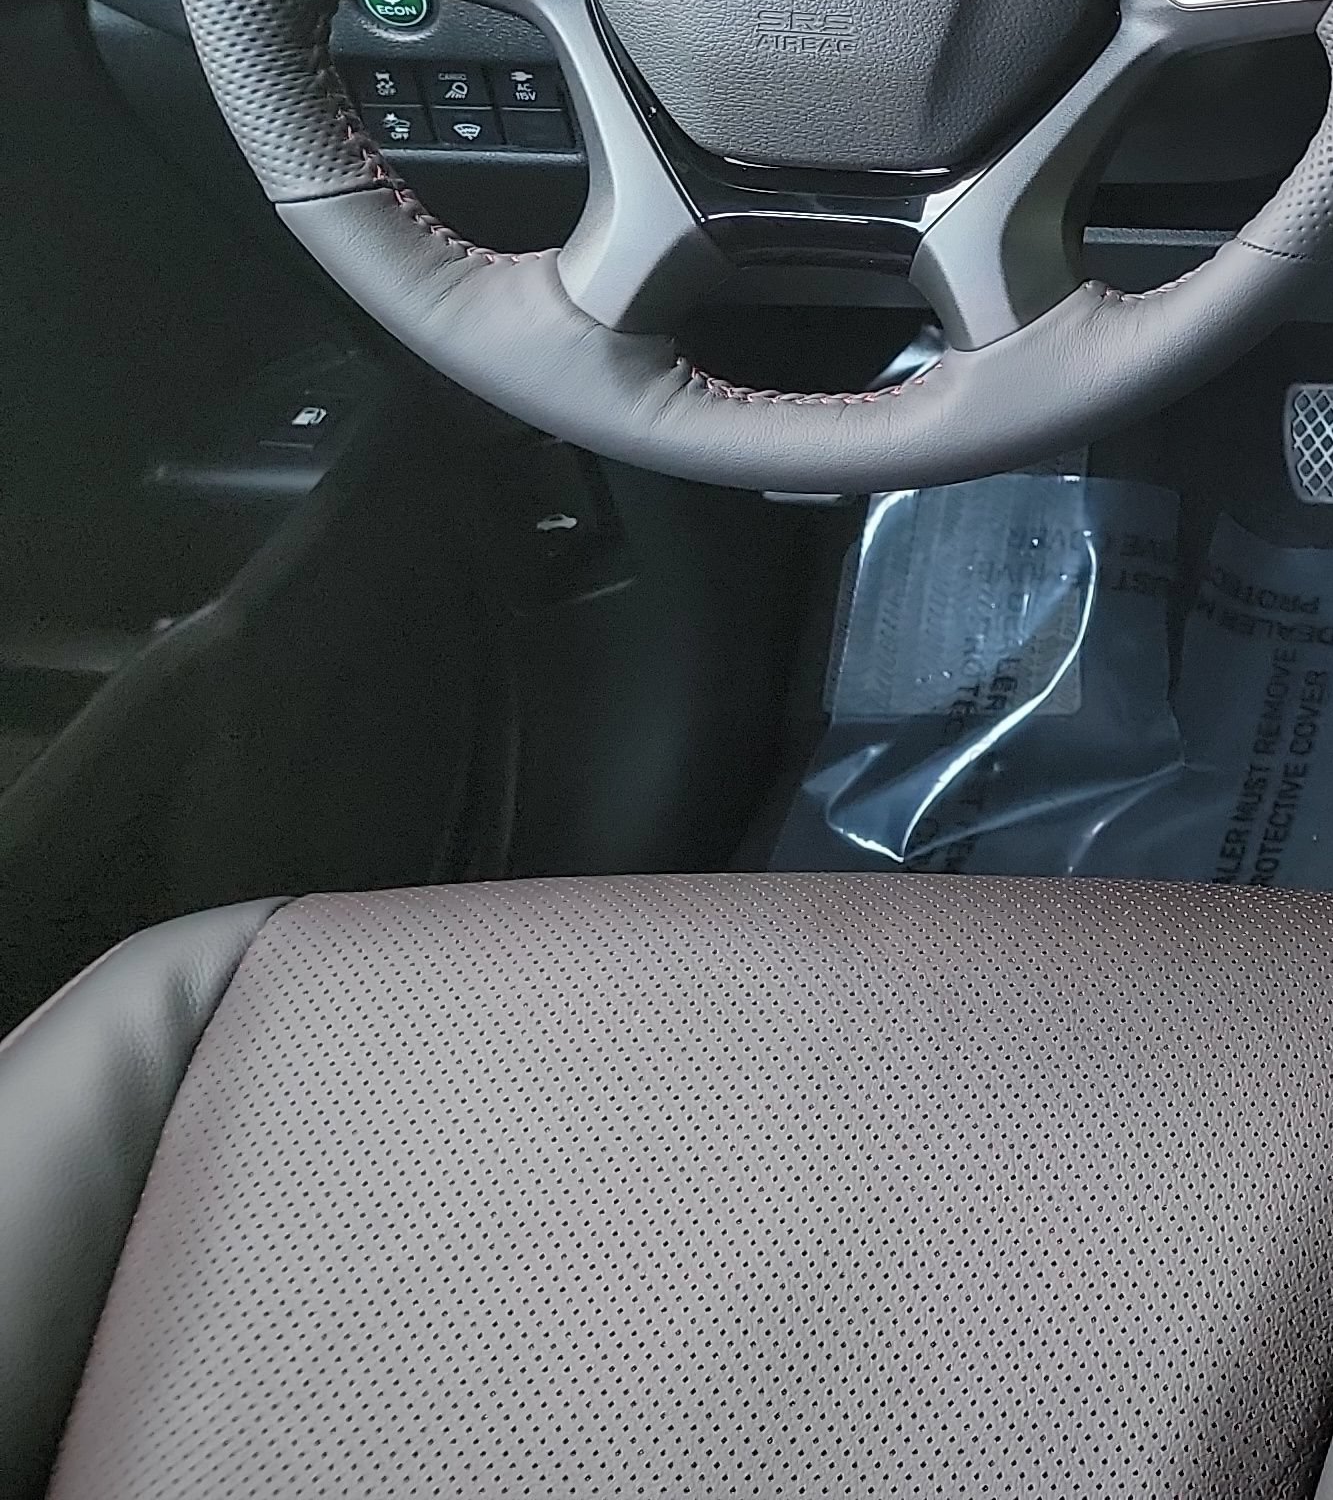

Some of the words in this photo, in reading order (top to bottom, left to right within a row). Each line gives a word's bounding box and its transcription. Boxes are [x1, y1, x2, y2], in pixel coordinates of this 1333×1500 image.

[377, 5, 418, 16] ECON
[757, 10, 853, 30] SRS
[517, 83, 532, 92] AC
[1232, 763, 1271, 826] MUST
[1253, 649, 1297, 754] REMOVE
[1250, 762, 1309, 885] ROTECTIVE
[1290, 670, 1329, 756] COVER
